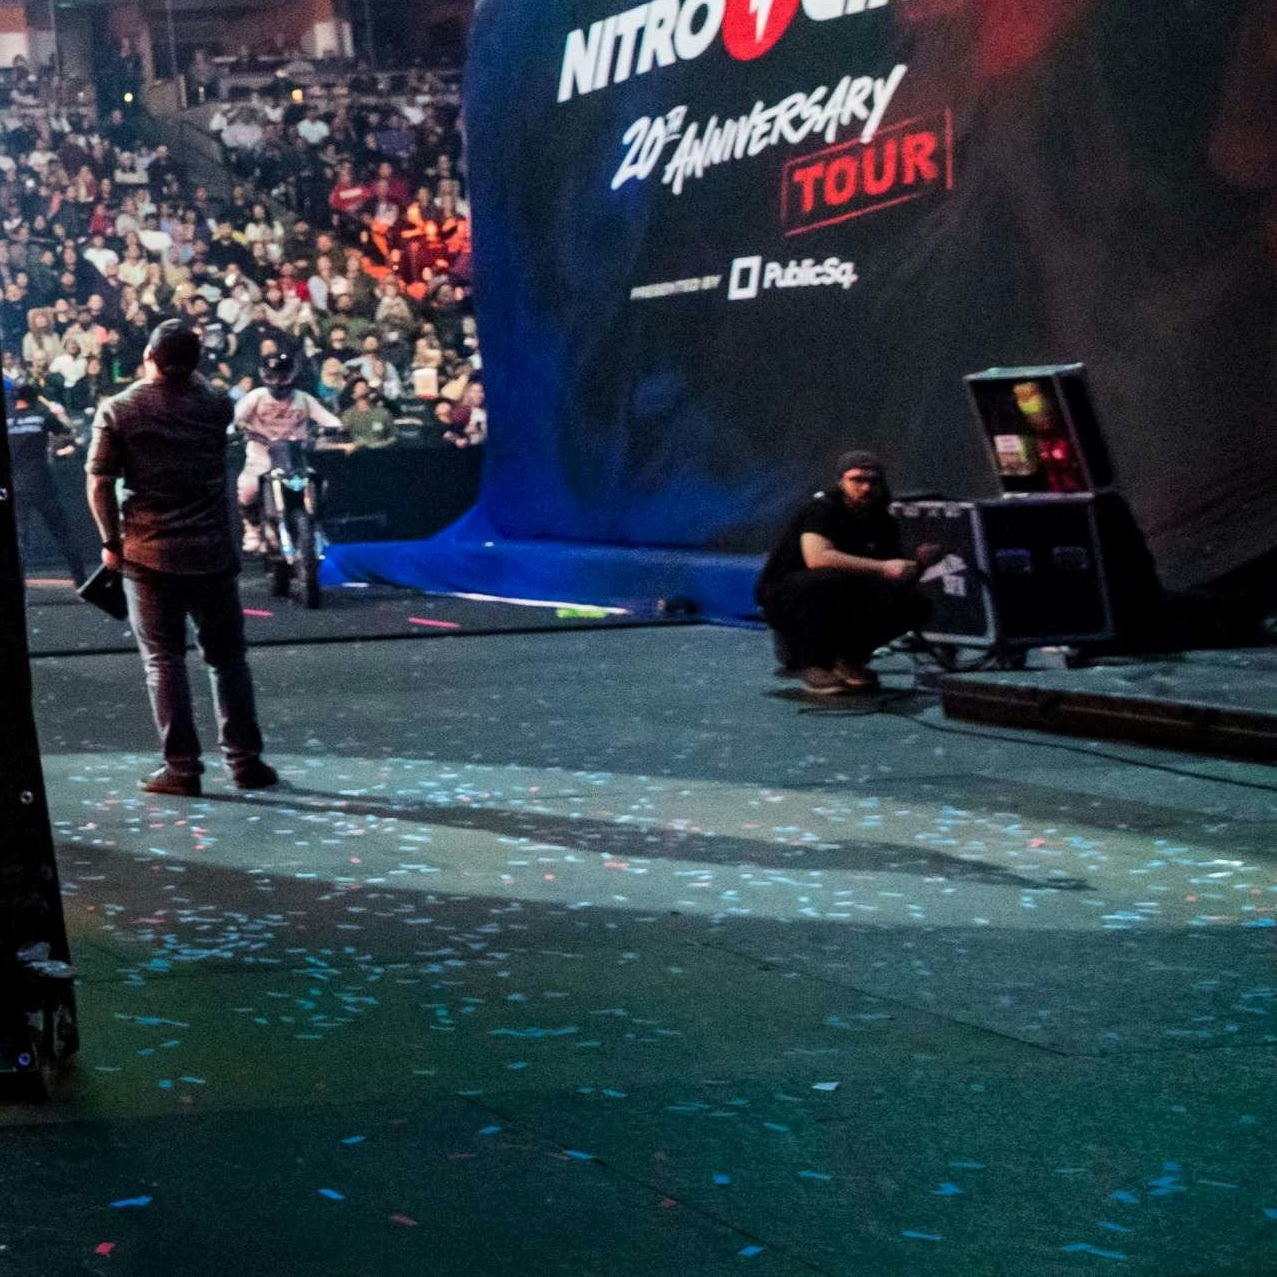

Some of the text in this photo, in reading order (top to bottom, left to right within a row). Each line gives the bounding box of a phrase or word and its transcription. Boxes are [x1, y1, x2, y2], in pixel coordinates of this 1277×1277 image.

[661, 64, 908, 196] ANNIVERSARY
[792, 131, 938, 213] TOUR
[763, 256, 859, 290] PublicSq.
